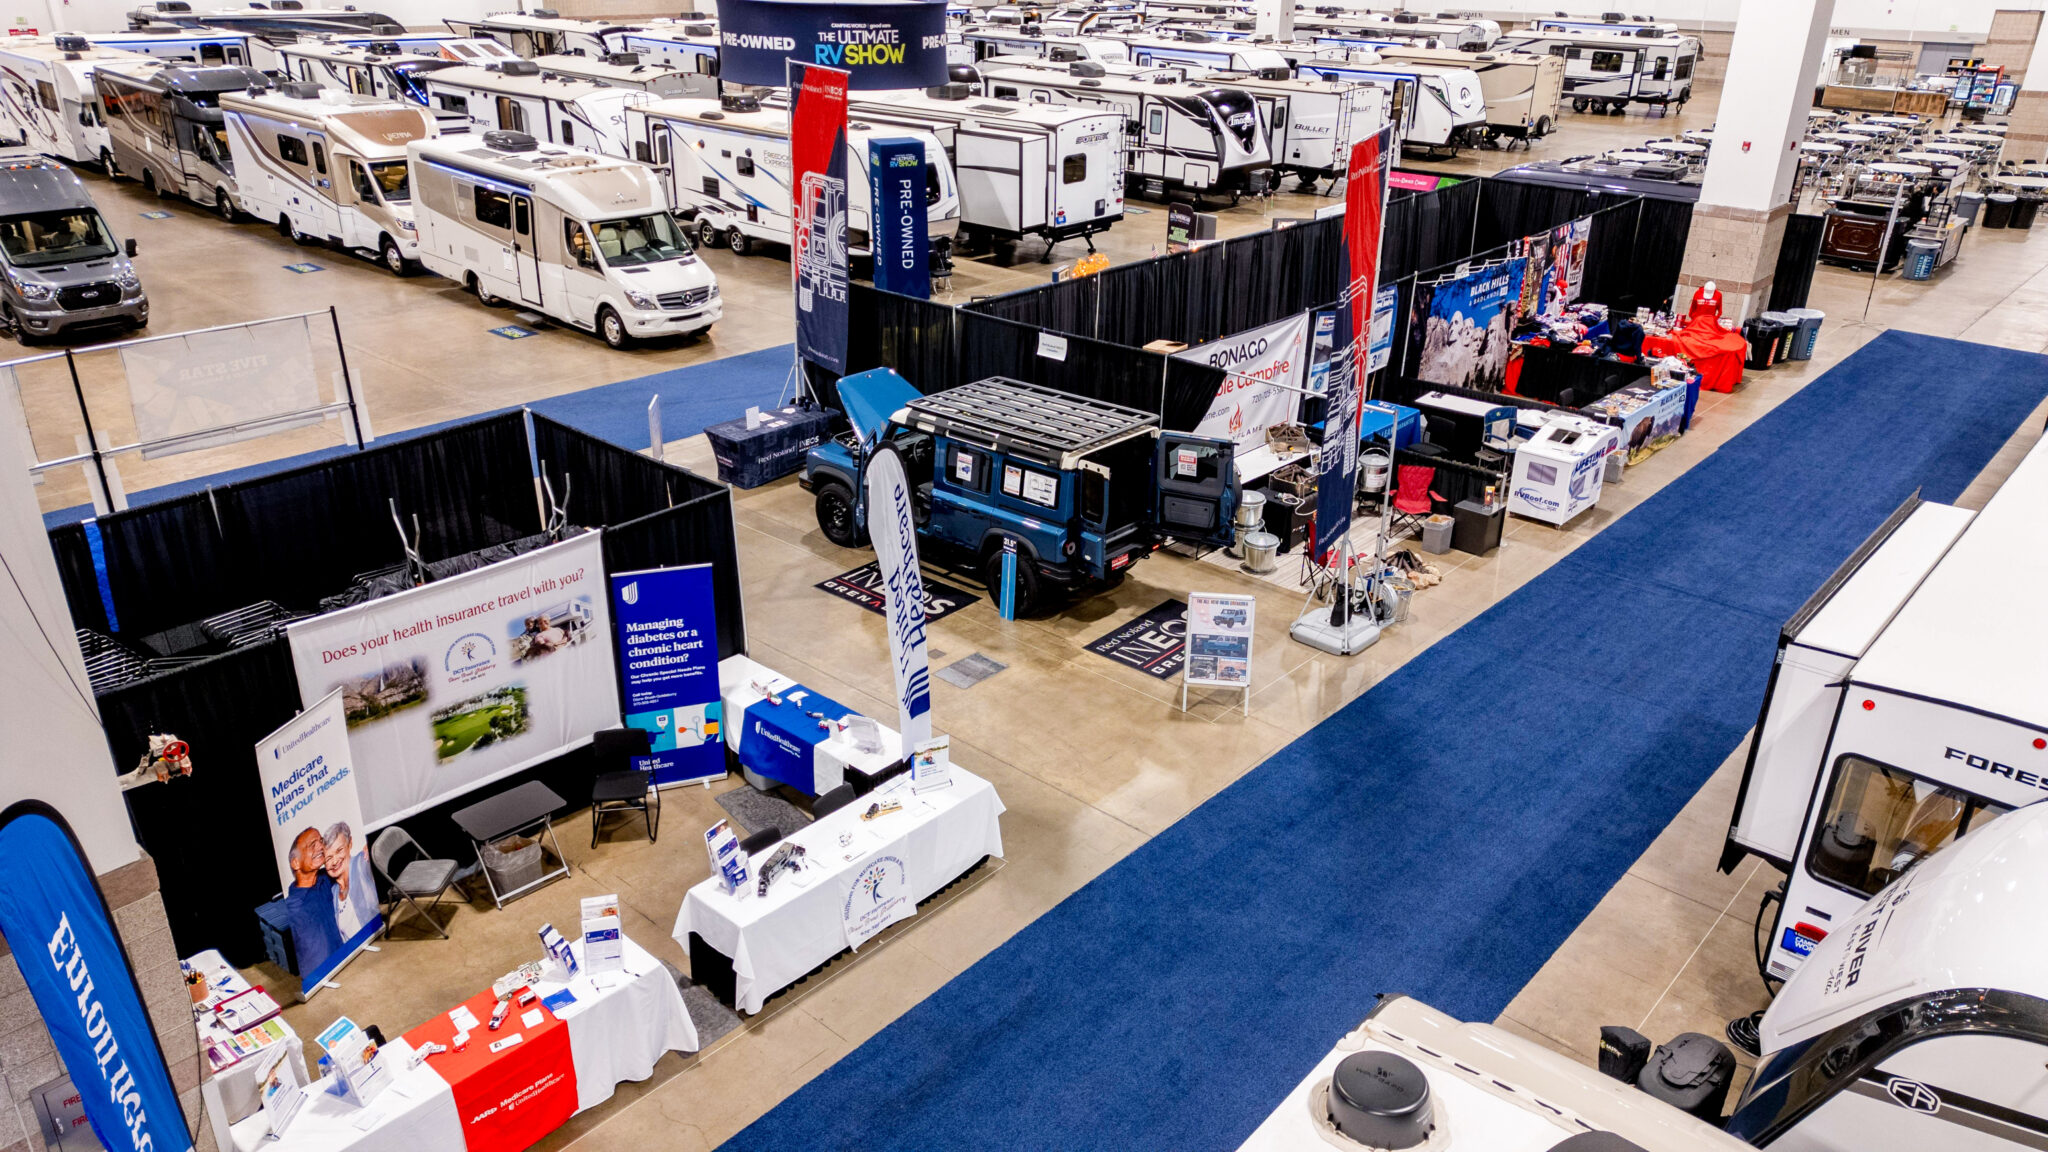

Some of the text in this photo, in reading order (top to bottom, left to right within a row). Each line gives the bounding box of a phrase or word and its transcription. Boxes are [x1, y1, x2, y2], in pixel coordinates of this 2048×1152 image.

[722, 31, 796, 51] PRE-OWNED
[818, 29, 899, 45] THE ULTIMATE
[815, 43, 905, 65] RV SHOW
[1294, 123, 1331, 134] BULLET
[898, 159, 918, 168] SHOW
[874, 177, 882, 267] PRE-OWNED
[899, 179, 914, 269] PRE-OWNED
[1470, 274, 1510, 297] BLACK HILLS
[1209, 337, 1268, 369] BONAGO
[799, 435, 820, 448] INEOS
[757, 455, 773, 465] Red
[773, 446, 796, 460] Noland
[894, 484, 926, 652] Healthcare
[321, 567, 585, 664] Does your health insurance travel with you?
[626, 618, 684, 633] Managing
[888, 564, 911, 678] United
[627, 629, 698, 645] diabetes or a
[628, 639, 704, 658] chronic heart
[1096, 620, 1155, 653] Red Noland
[1111, 611, 1188, 666] INEO
[629, 653, 689, 670] condition?
[281, 715, 332, 754] UnitedHealthcare
[760, 727, 801, 753] UnitedHealthcare
[639, 757, 661, 767] Unied
[639, 761, 674, 772] Heathcare
[271, 754, 324, 799] Medicare
[274, 764, 330, 815] plans that
[276, 765, 351, 826] fit your needs.
[1846, 924, 1861, 951] EAST
[1844, 918, 1879, 990] RIVER
[1833, 963, 1845, 994] WEST
[63, 1093, 82, 1108] FIRE
[470, 1073, 565, 1124] AARP UnitedHealthcare
[500, 1072, 553, 1108] Medicare Plans
[72, 1114, 90, 1128] FIRE
